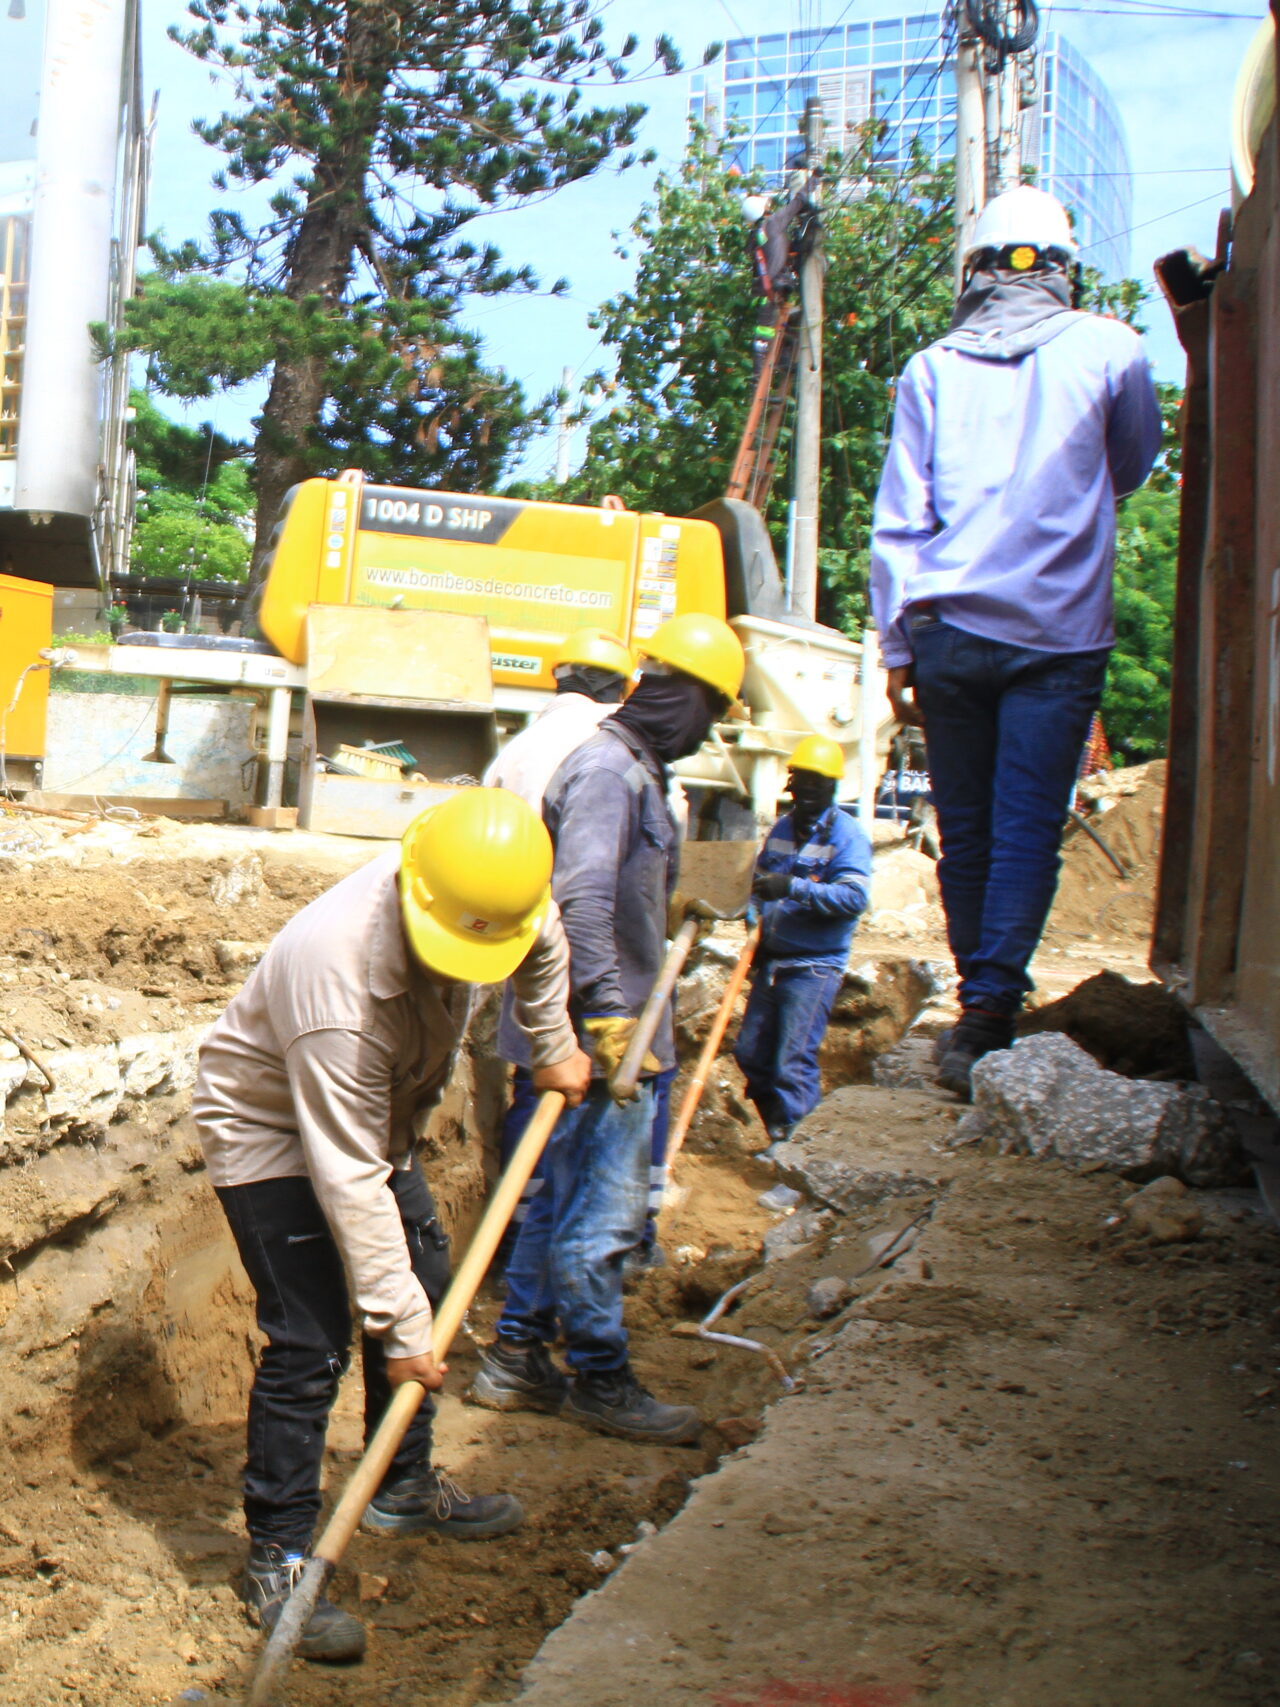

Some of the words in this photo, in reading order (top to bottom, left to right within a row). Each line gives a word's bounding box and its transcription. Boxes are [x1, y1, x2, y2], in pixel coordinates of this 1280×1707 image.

[366, 498, 420, 524] 1004
[425, 504, 444, 527] D
[447, 506, 493, 532] SHP
[365, 566, 613, 608] www.bombeosdeconcreto.com
